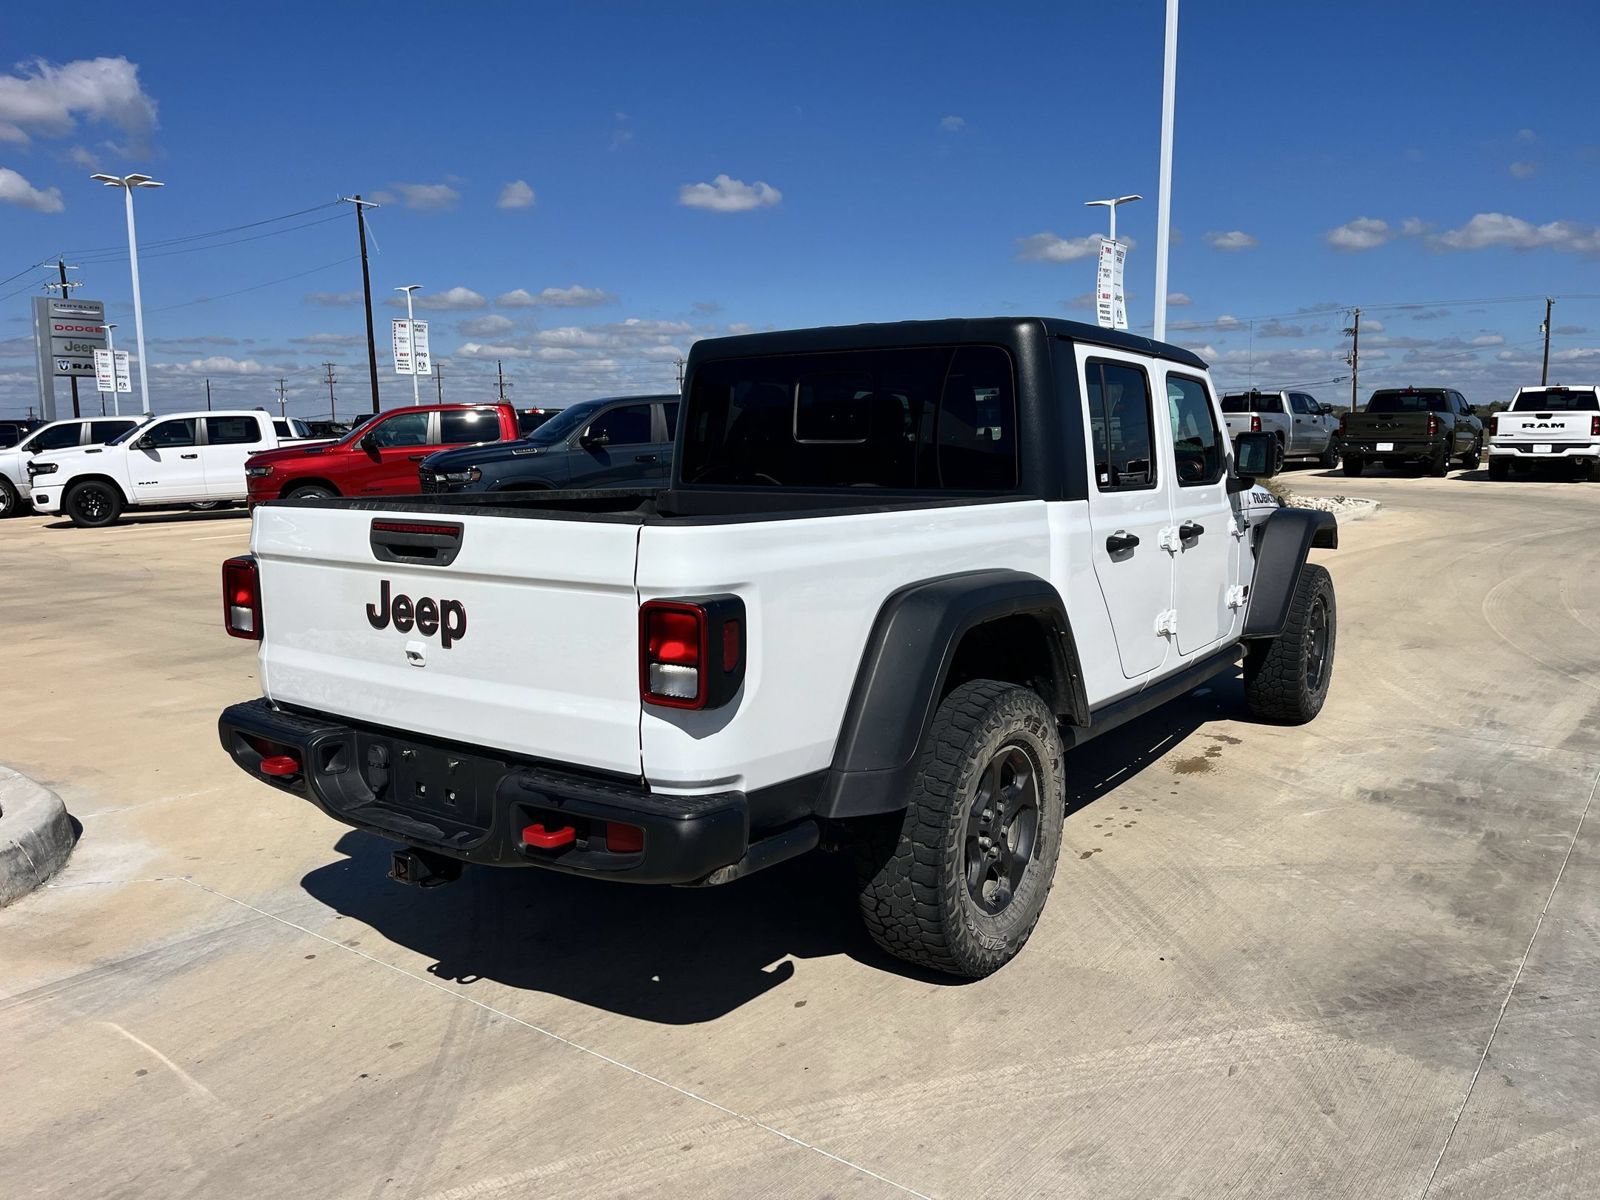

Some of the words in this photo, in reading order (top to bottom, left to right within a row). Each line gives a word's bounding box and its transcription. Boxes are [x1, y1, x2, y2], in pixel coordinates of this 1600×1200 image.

[54, 324, 103, 333] DODGE
[64, 341, 97, 353] Jeep
[1252, 492, 1276, 504] RUBICO
[366, 579, 467, 650] Jeep
